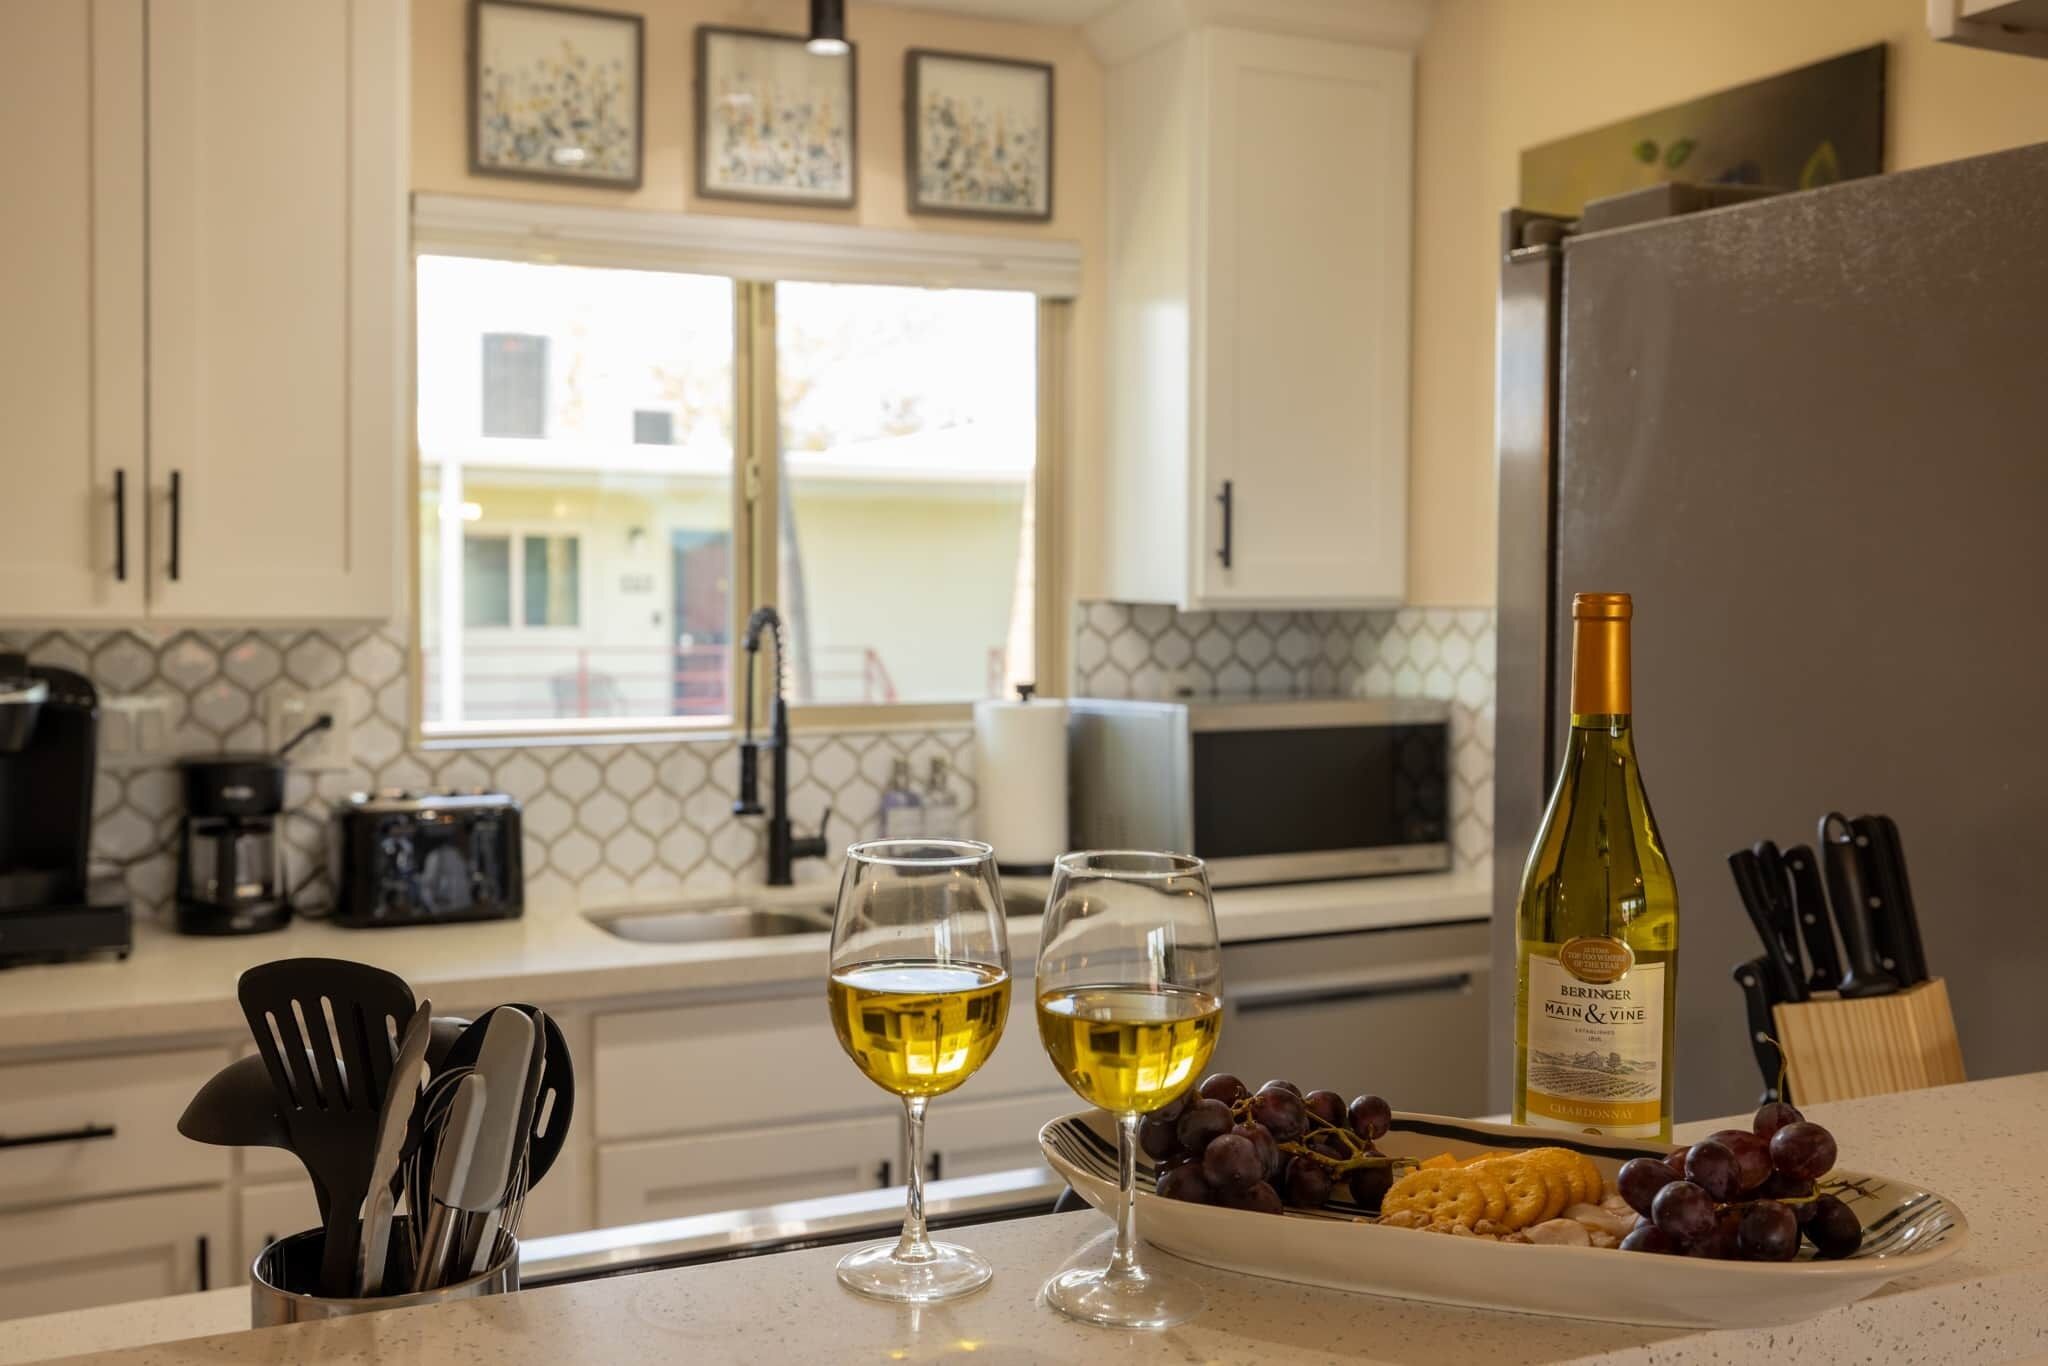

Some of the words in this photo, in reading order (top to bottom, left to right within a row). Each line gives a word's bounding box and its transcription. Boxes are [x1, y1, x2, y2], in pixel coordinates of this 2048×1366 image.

[1561, 984, 1631, 1000] BERINGER
[1545, 1003, 1582, 1017] MAIN
[1585, 1003, 1608, 1025] &
[1610, 1010, 1645, 1020] VINE
[1550, 1103, 1634, 1120] CHARDONNAY
